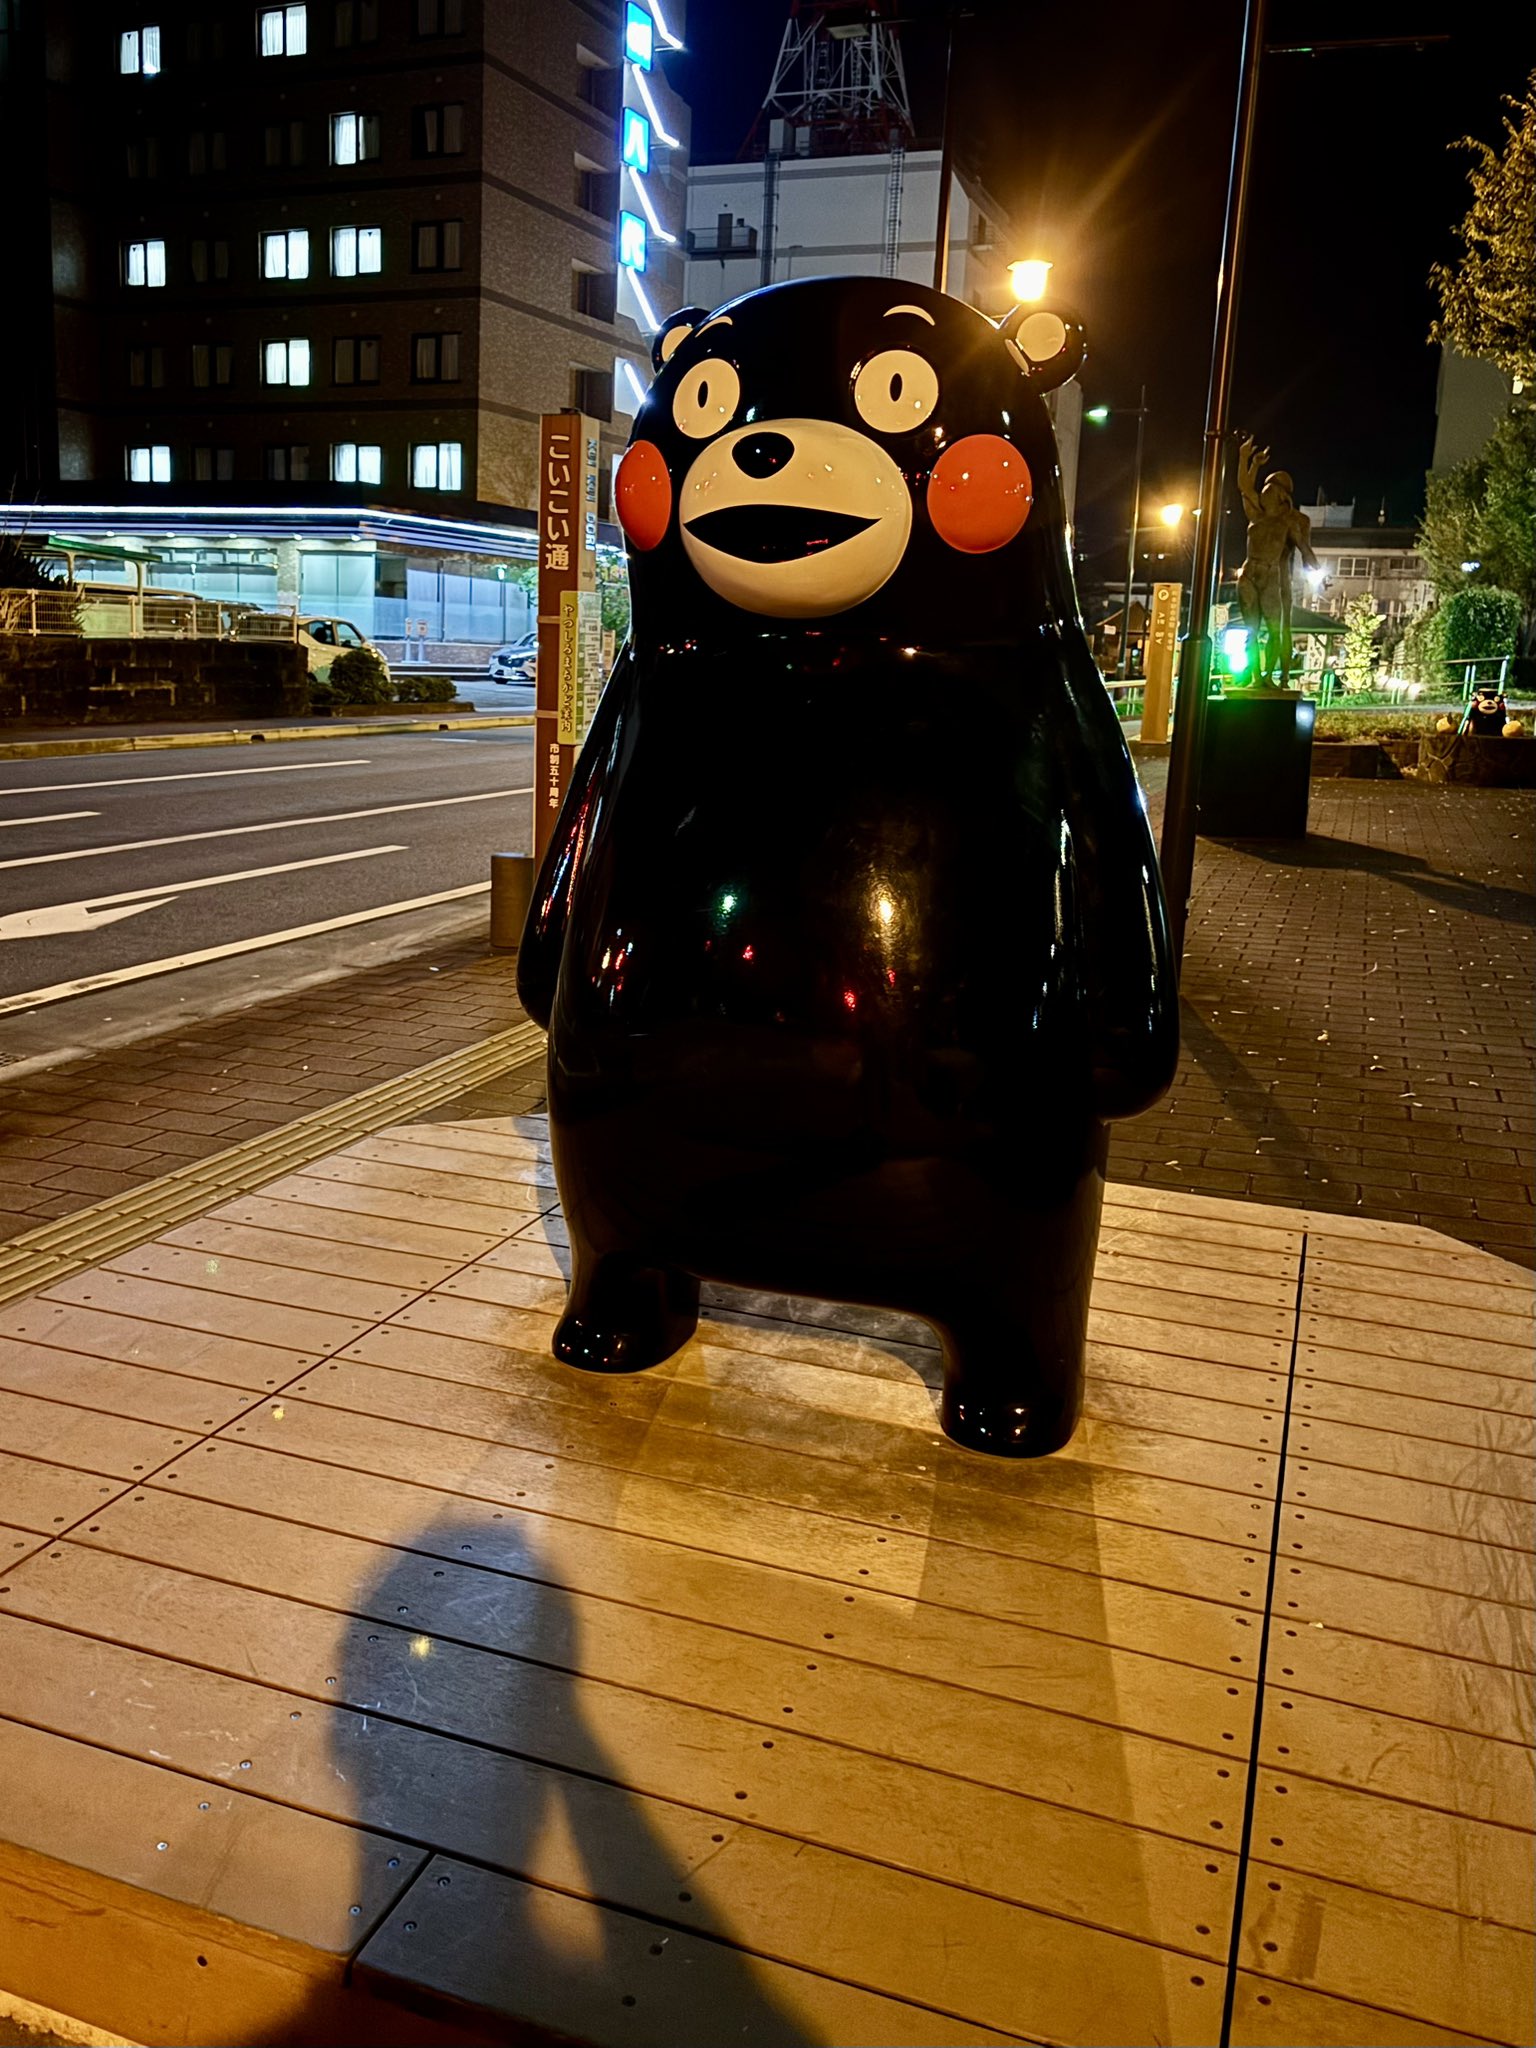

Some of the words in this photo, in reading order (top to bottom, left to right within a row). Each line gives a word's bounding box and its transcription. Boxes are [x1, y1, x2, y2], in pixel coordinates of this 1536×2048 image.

[545, 434, 570, 571] こいこい通
